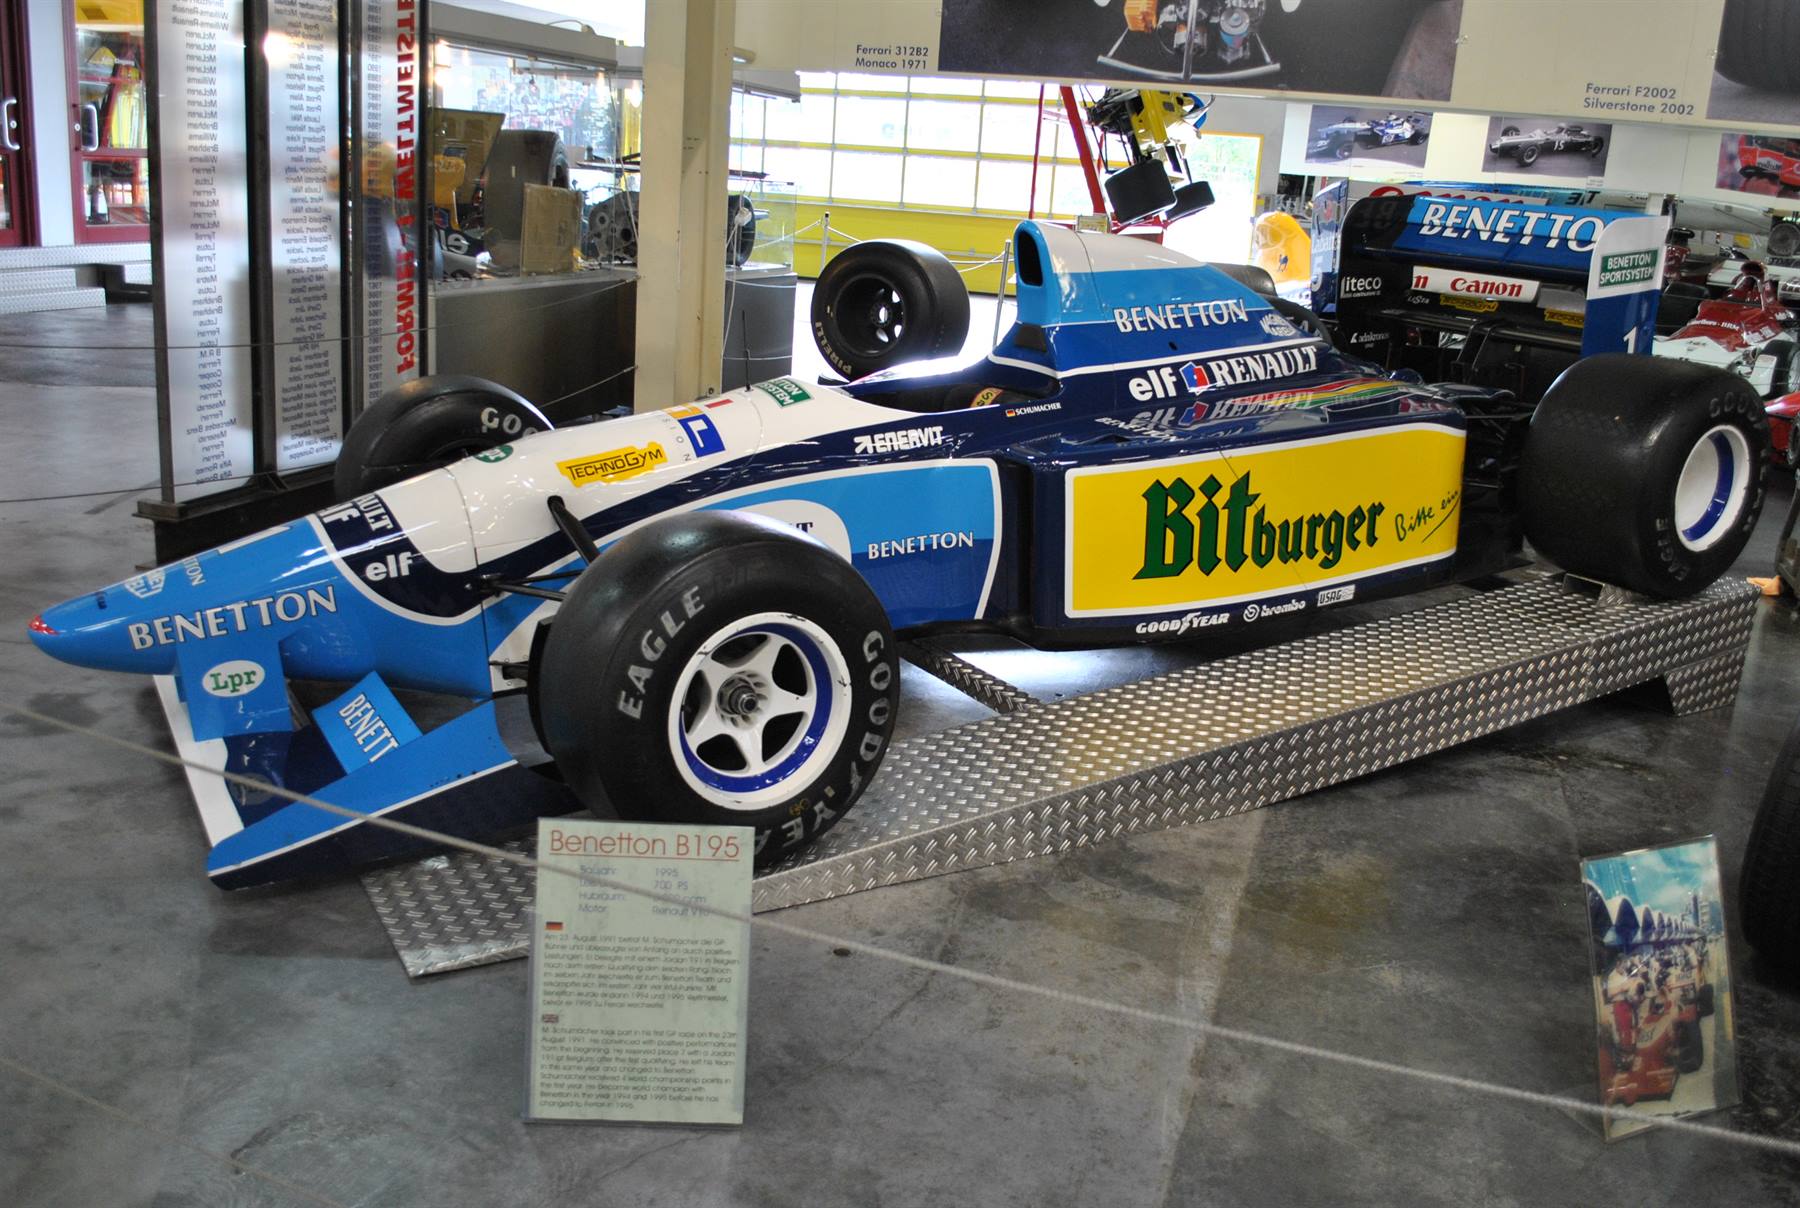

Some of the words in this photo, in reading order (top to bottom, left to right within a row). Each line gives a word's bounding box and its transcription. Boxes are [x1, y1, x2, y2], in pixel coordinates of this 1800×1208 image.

[856, 44, 891, 57] Ferrari
[895, 45, 930, 58] 312B2
[855, 57, 897, 70] Monaco
[901, 58, 928, 70] 1971
[1585, 83, 1630, 98] Ferrari
[1636, 85, 1677, 100] F2002
[1583, 96, 1655, 114] Silverstone
[1659, 101, 1695, 116] 2002
[1418, 204, 1605, 252] BENETTO
[1606, 252, 1652, 269] BENETTON
[1450, 277, 1524, 297] Canon
[1600, 267, 1655, 286] SPORTSYSTEM
[1113, 298, 1249, 333] BENETTON
[815, 321, 853, 376] PIRELLI
[1128, 366, 1180, 401] elf
[1210, 346, 1318, 387] RENAULT
[1015, 402, 1062, 416] SCHUMACHER
[1132, 470, 1385, 581] Bitburger
[868, 530, 973, 560] BENETTON
[365, 551, 414, 581] elf
[1261, 599, 1307, 617] brembo
[1319, 589, 1342, 605] USAG
[128, 585, 337, 650] BENETTON
[1136, 611, 1230, 635] GOODYEAR
[618, 585, 708, 720] EAGLE
[210, 670, 257, 693] Lpr
[339, 692, 400, 763] BENETT
[549, 829, 666, 854] Benetton
[676, 834, 740, 858] B195
